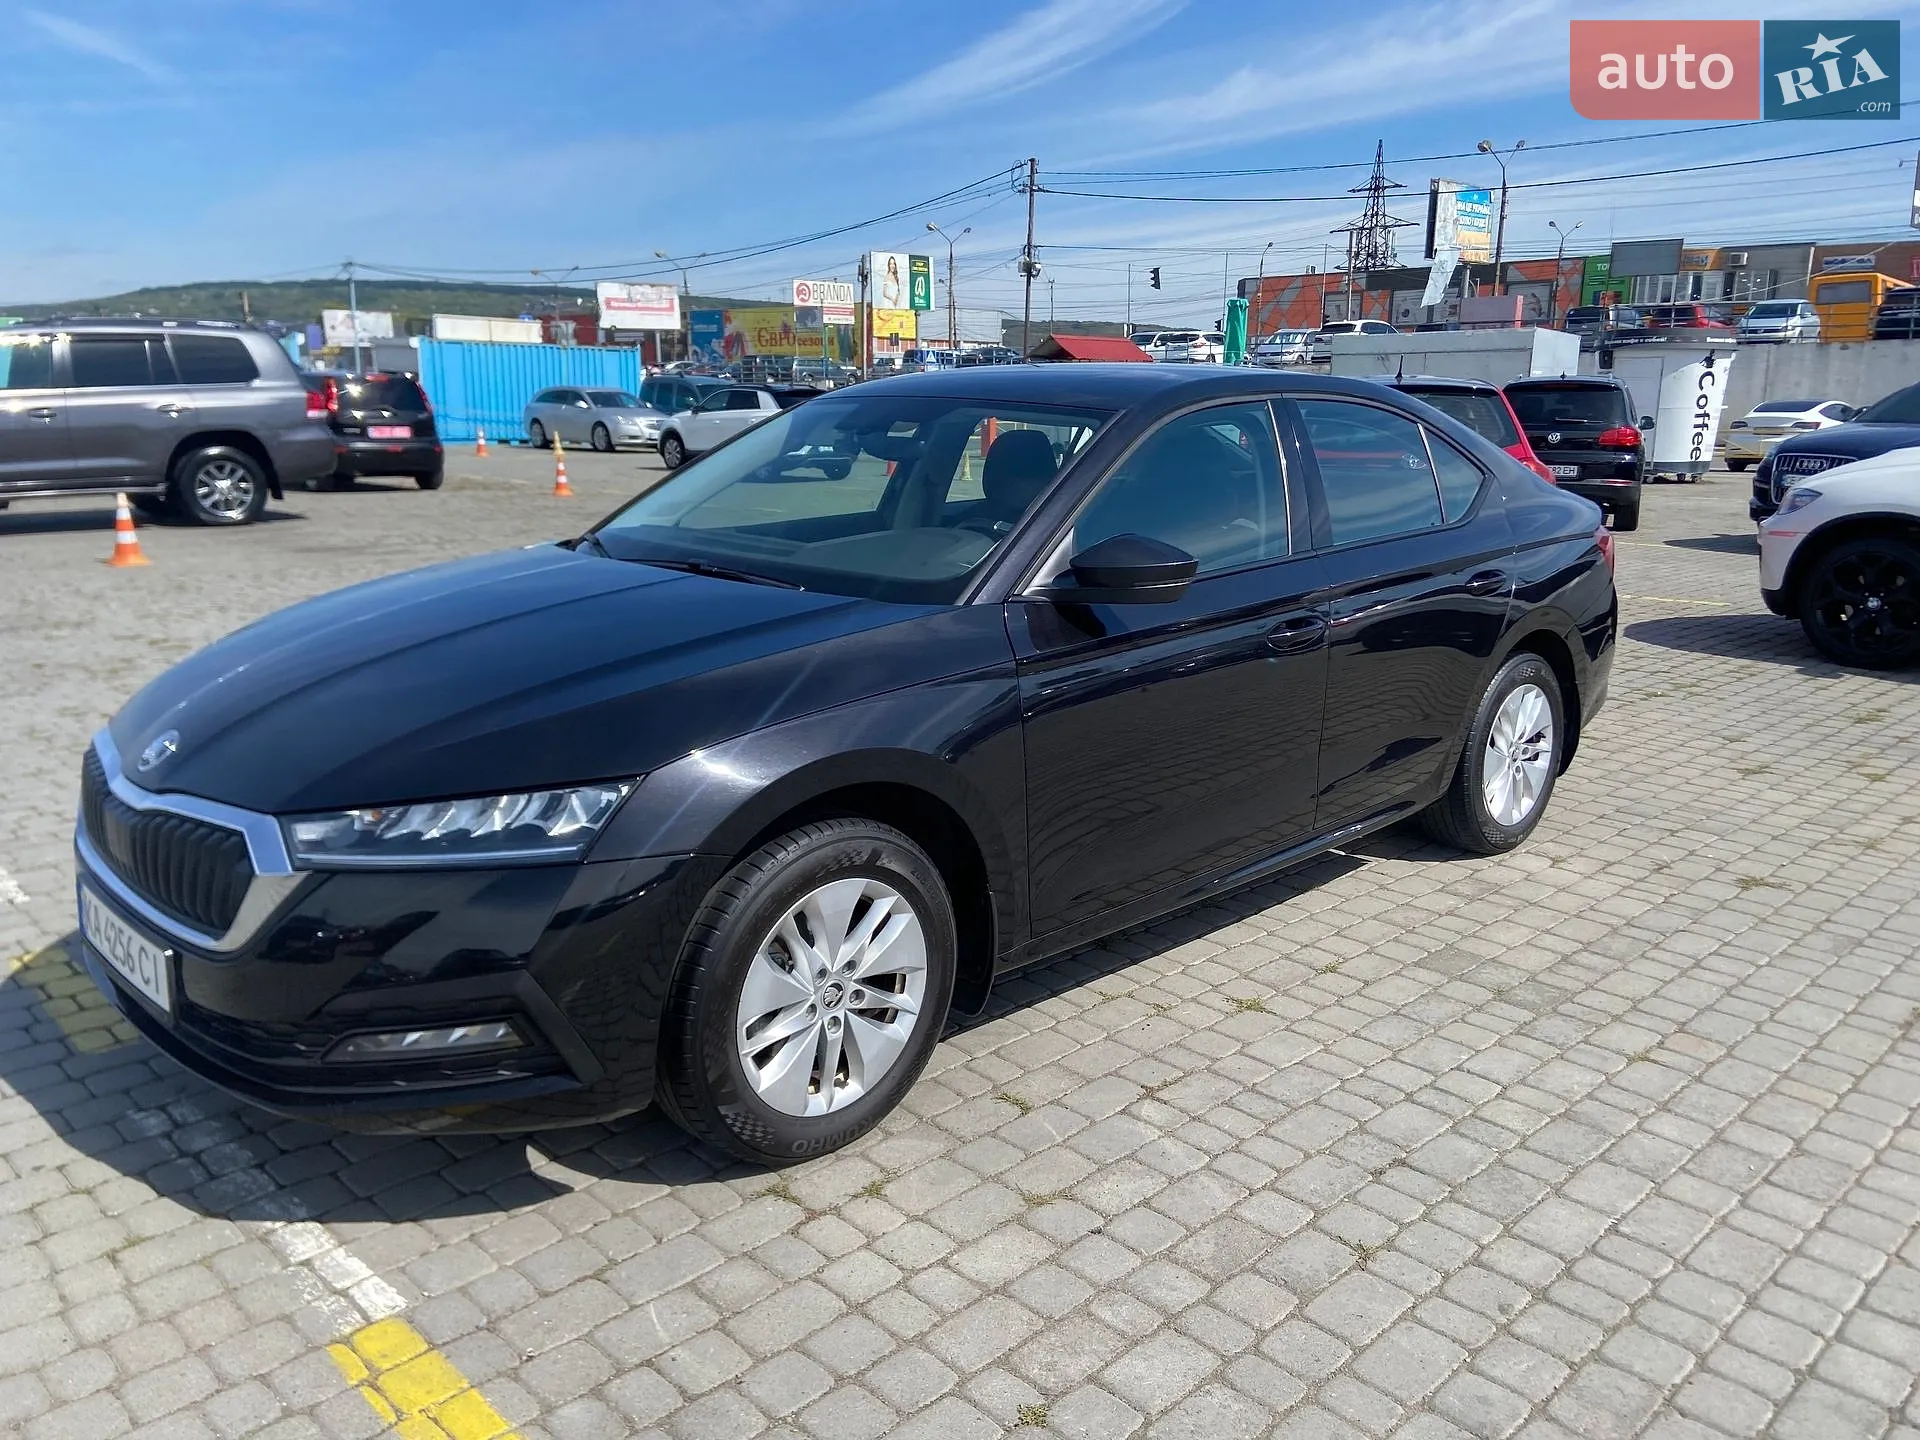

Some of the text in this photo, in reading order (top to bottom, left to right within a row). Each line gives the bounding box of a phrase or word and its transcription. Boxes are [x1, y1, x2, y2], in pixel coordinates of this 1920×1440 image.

[812, 282, 851, 302] BRANDA
[1690, 371, 1715, 461] Coffee
[1563, 466, 1575, 475] EH
[104, 915, 135, 973] 4256
[138, 944, 160, 995] CI
